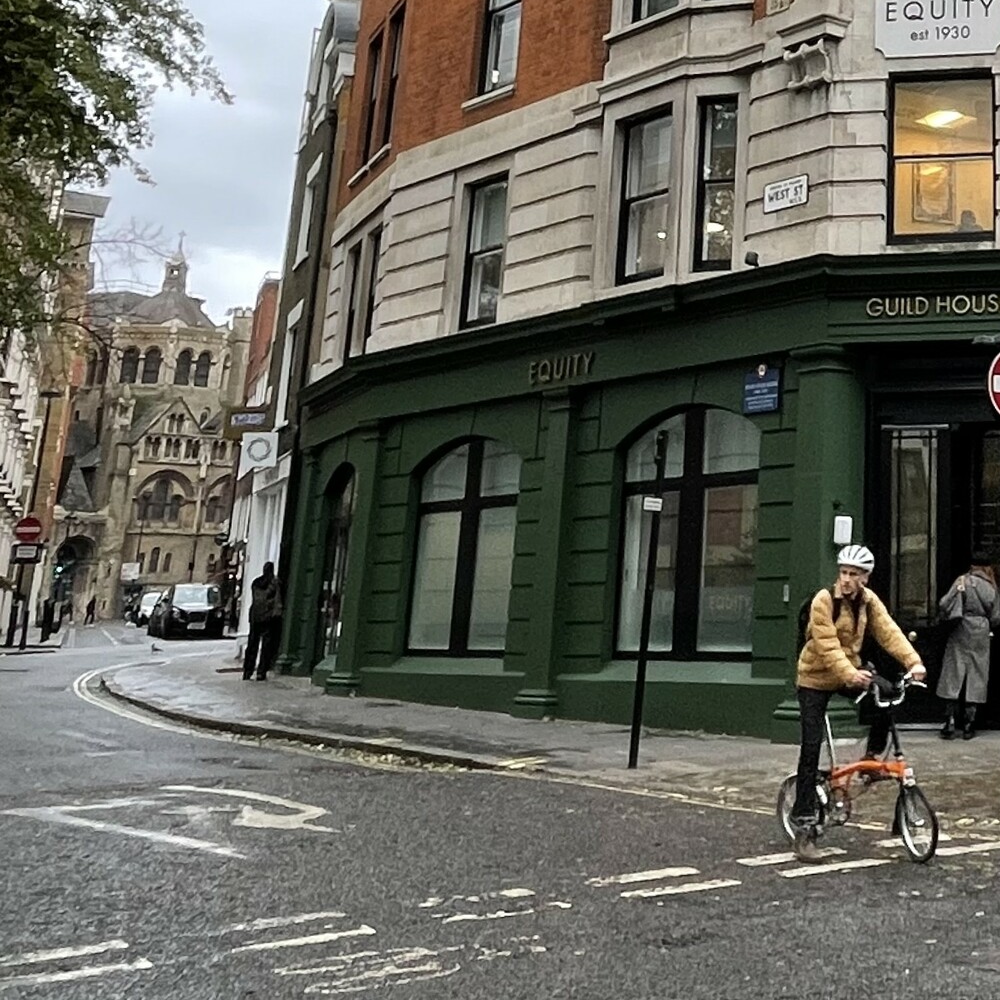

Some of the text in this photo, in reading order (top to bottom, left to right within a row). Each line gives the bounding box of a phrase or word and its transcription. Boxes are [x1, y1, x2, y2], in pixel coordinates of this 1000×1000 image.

[910, 25, 971, 41] est 1930
[768, 187, 790, 203] WEST
[793, 184, 803, 197] ST
[866, 297, 929, 317] GUILD
[528, 351, 593, 386] EQUITY
